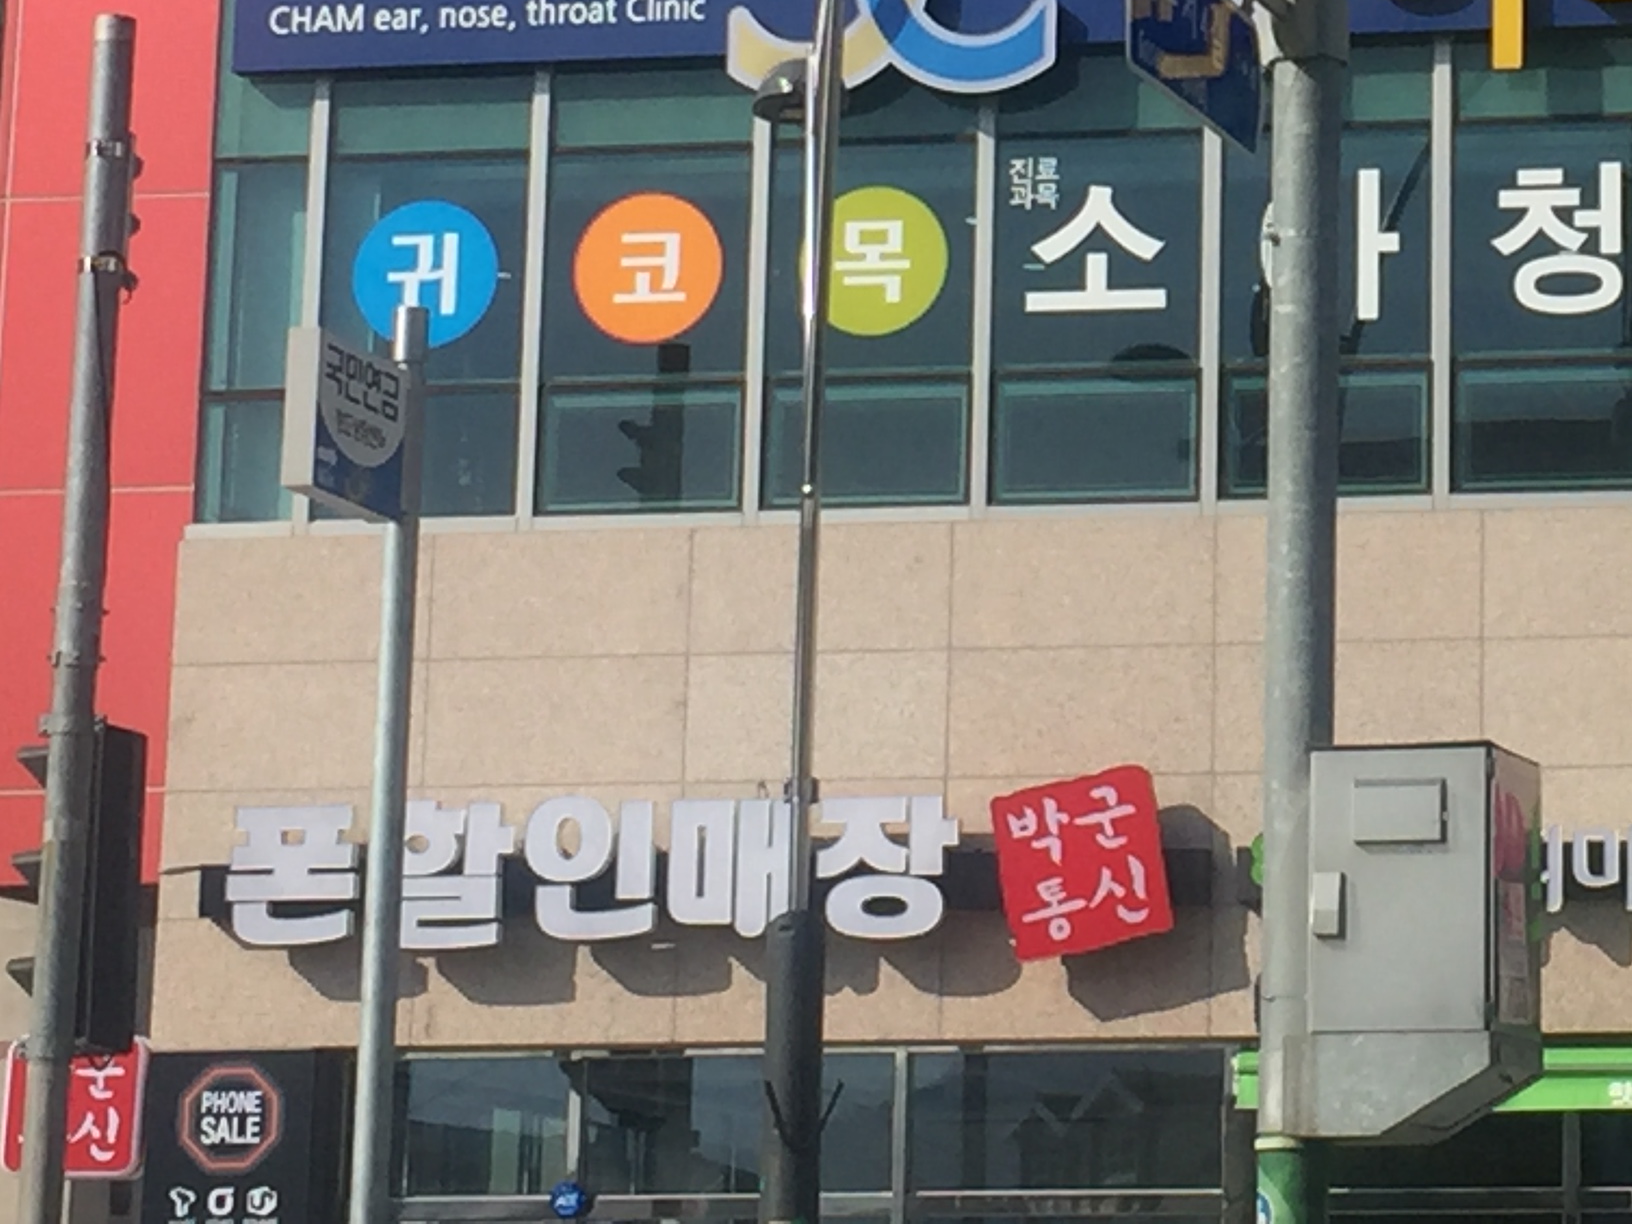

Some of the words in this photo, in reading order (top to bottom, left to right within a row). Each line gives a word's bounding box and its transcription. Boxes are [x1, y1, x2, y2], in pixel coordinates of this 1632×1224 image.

[267, 3, 364, 36] CHAM
[373, 4, 428, 35] ear,
[438, 1, 516, 32] nose,
[387, 231, 460, 316] 귀
[612, 230, 687, 305] 코
[834, 219, 911, 304] 목
[1006, 784, 1137, 866] 박군
[1020, 853, 1151, 942] 통신
[200, 1090, 263, 1114] PHONE
[200, 1115, 261, 1145] SALE
